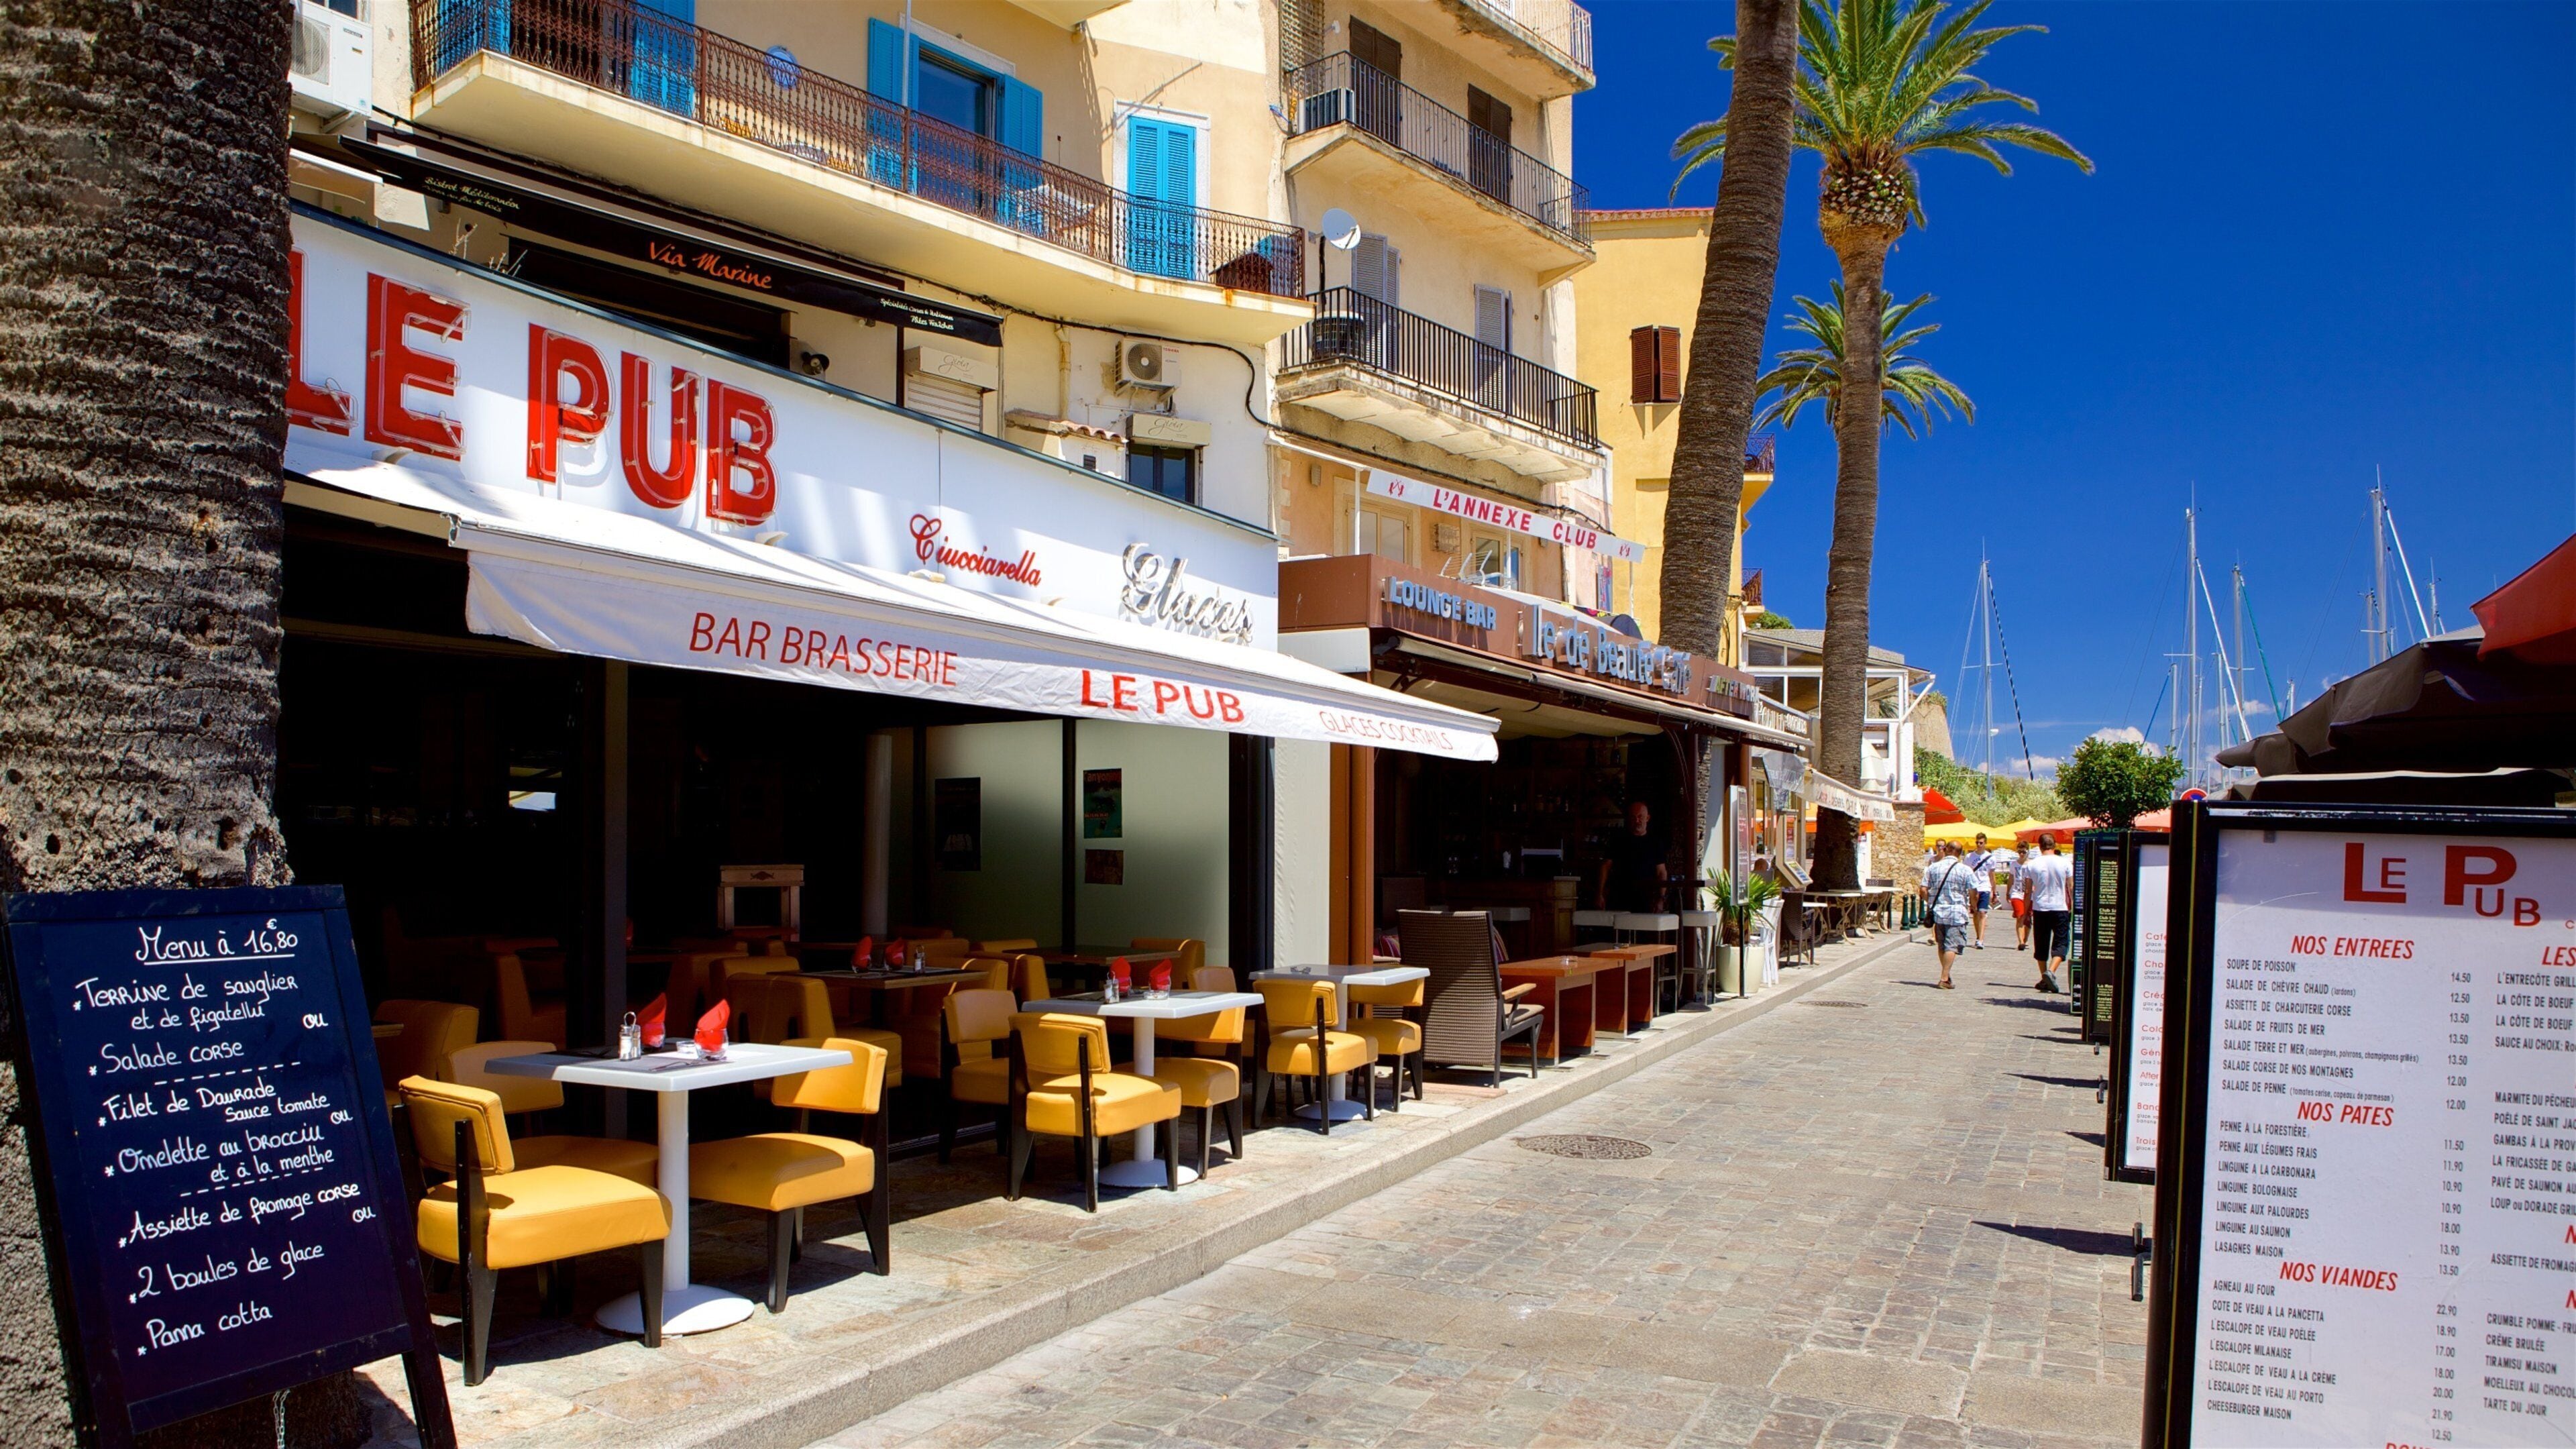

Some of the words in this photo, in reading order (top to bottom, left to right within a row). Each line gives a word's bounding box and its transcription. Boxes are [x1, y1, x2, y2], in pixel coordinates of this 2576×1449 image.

[650, 241, 686, 267] Via
[692, 253, 771, 288] Marine
[285, 246, 471, 462] LE
[525, 322, 780, 527] PUB
[1433, 488, 1532, 532] L'ANNEXE
[1553, 522, 1597, 549] CLUB
[910, 514, 1042, 587] Ciucciarella
[1121, 542, 1254, 644] Glaces
[1387, 576, 1462, 621] LOUNGE
[1466, 599, 1497, 631] BAR
[1566, 615, 1590, 670] de
[689, 612, 771, 659] BAR
[780, 627, 957, 687] BRASSERIE
[1080, 669, 1138, 712] LE
[1155, 682, 1246, 722] PUB
[1319, 710, 1381, 739] GLACES
[1380, 722, 1454, 751] COCKTAILS
[136, 926, 210, 961] Menu
[218, 930, 235, 955] à
[2291, 935, 2327, 955] NOS
[2334, 937, 2414, 959] ENTREES
[2226, 959, 2249, 970] SOUPE
[2252, 960, 2261, 971] DE
[2264, 961, 2296, 973] POISSON
[181, 973, 208, 999] de
[2226, 979, 2253, 991] SALADE
[2257, 981, 2267, 991] DE
[2271, 979, 2299, 993] CHÈVRE
[2304, 983, 2328, 994] CHAUD
[2451, 972, 2471, 983] 14.50
[2225, 1000, 2257, 1012] ASSIETTE
[2261, 1001, 2271, 1012] DE
[2275, 1002, 2324, 1014] CHARCUTERIE
[2326, 1005, 2351, 1016] CORSE
[2451, 993, 2470, 1004] 12.50
[2497, 994, 2506, 1006] LA
[2510, 993, 2531, 1007] CÔTE
[2534, 996, 2545, 1008] DE
[2548, 997, 2574, 1009] BOEUF
[131, 1008, 154, 1030] et
[160, 1008, 182, 1028] de
[302, 1013, 329, 1029] ou
[2224, 1019, 2251, 1031] SALADE
[2256, 1021, 2265, 1032] DE
[2269, 1022, 2293, 1034] FRUITS
[2298, 1023, 2307, 1034] DE
[2310, 1024, 2325, 1035] MER
[2449, 1013, 2469, 1024] 13.50
[2449, 1034, 2469, 1044] 13.50
[101, 1042, 182, 1073] Salade
[103, 1092, 158, 1122] Filet
[166, 1090, 190, 1113] de
[278, 1092, 330, 1114] tomate
[330, 1109, 354, 1124] ou
[2297, 1102, 2334, 1122] NOS
[2340, 1104, 2394, 1126] PATES
[118, 1136, 210, 1173] Omelette
[219, 1140, 242, 1157] au
[2219, 1140, 2241, 1152] PENNE
[2244, 1142, 2258, 1154] AUX
[2261, 1142, 2294, 1157] LÉGUMES
[2296, 1147, 2318, 1159] FRAIS
[210, 1163, 229, 1183] et
[237, 1161, 252, 1178] à
[254, 1155, 273, 1175] la
[280, 1144, 334, 1171] menthe
[2443, 1160, 2463, 1172] 11.90
[2217, 1181, 2248, 1193] LINGUINE
[2252, 1184, 2298, 1197] BOLOGNAISE
[352, 1206, 376, 1222] ou
[2216, 1201, 2247, 1214] LINGUINE
[2250, 1204, 2265, 1216] AUX
[2267, 1205, 2309, 1220] PALOURDES
[2441, 1202, 2461, 1214] 10.90
[129, 1207, 211, 1244] Assiette
[220, 1201, 242, 1223] de
[2440, 1222, 2461, 1234] 18.00
[2214, 1241, 2251, 1254] LASAGNES
[2255, 1245, 2284, 1258] MAISON
[138, 1266, 161, 1298] 2
[166, 1254, 238, 1291] boules
[248, 1248, 272, 1273] de
[280, 1240, 325, 1281] glace
[2279, 1262, 2316, 1283] NOS
[2322, 1265, 2398, 1291] VIANDES
[2213, 1280, 2241, 1293] AGNEAU
[2244, 1283, 2254, 1294] AU
[2257, 1283, 2275, 1296] FOUR
[2212, 1299, 2231, 1311] COTE
[2233, 1301, 2242, 1313] DE
[2246, 1303, 2264, 1315] VEAU
[2267, 1305, 2272, 1316] A
[2275, 1306, 2284, 1318] LA
[2288, 1308, 2324, 1322] PANCETTA
[2436, 1304, 2457, 1316] 22.90
[146, 1318, 205, 1349] Panna
[218, 1301, 273, 1331] cotta
[2436, 1325, 2456, 1337] 18.90
[2485, 1355, 2522, 1370] TIRAMISU
[2525, 1360, 2557, 1375] MAISON
[2207, 1399, 2260, 1416] CHEESEBURGER
[2263, 1406, 2292, 1420] MAISON
[2483, 1397, 2508, 1411] TARTE
[2511, 1401, 2522, 1413] DU
[2525, 1403, 2548, 1416] JOUR
